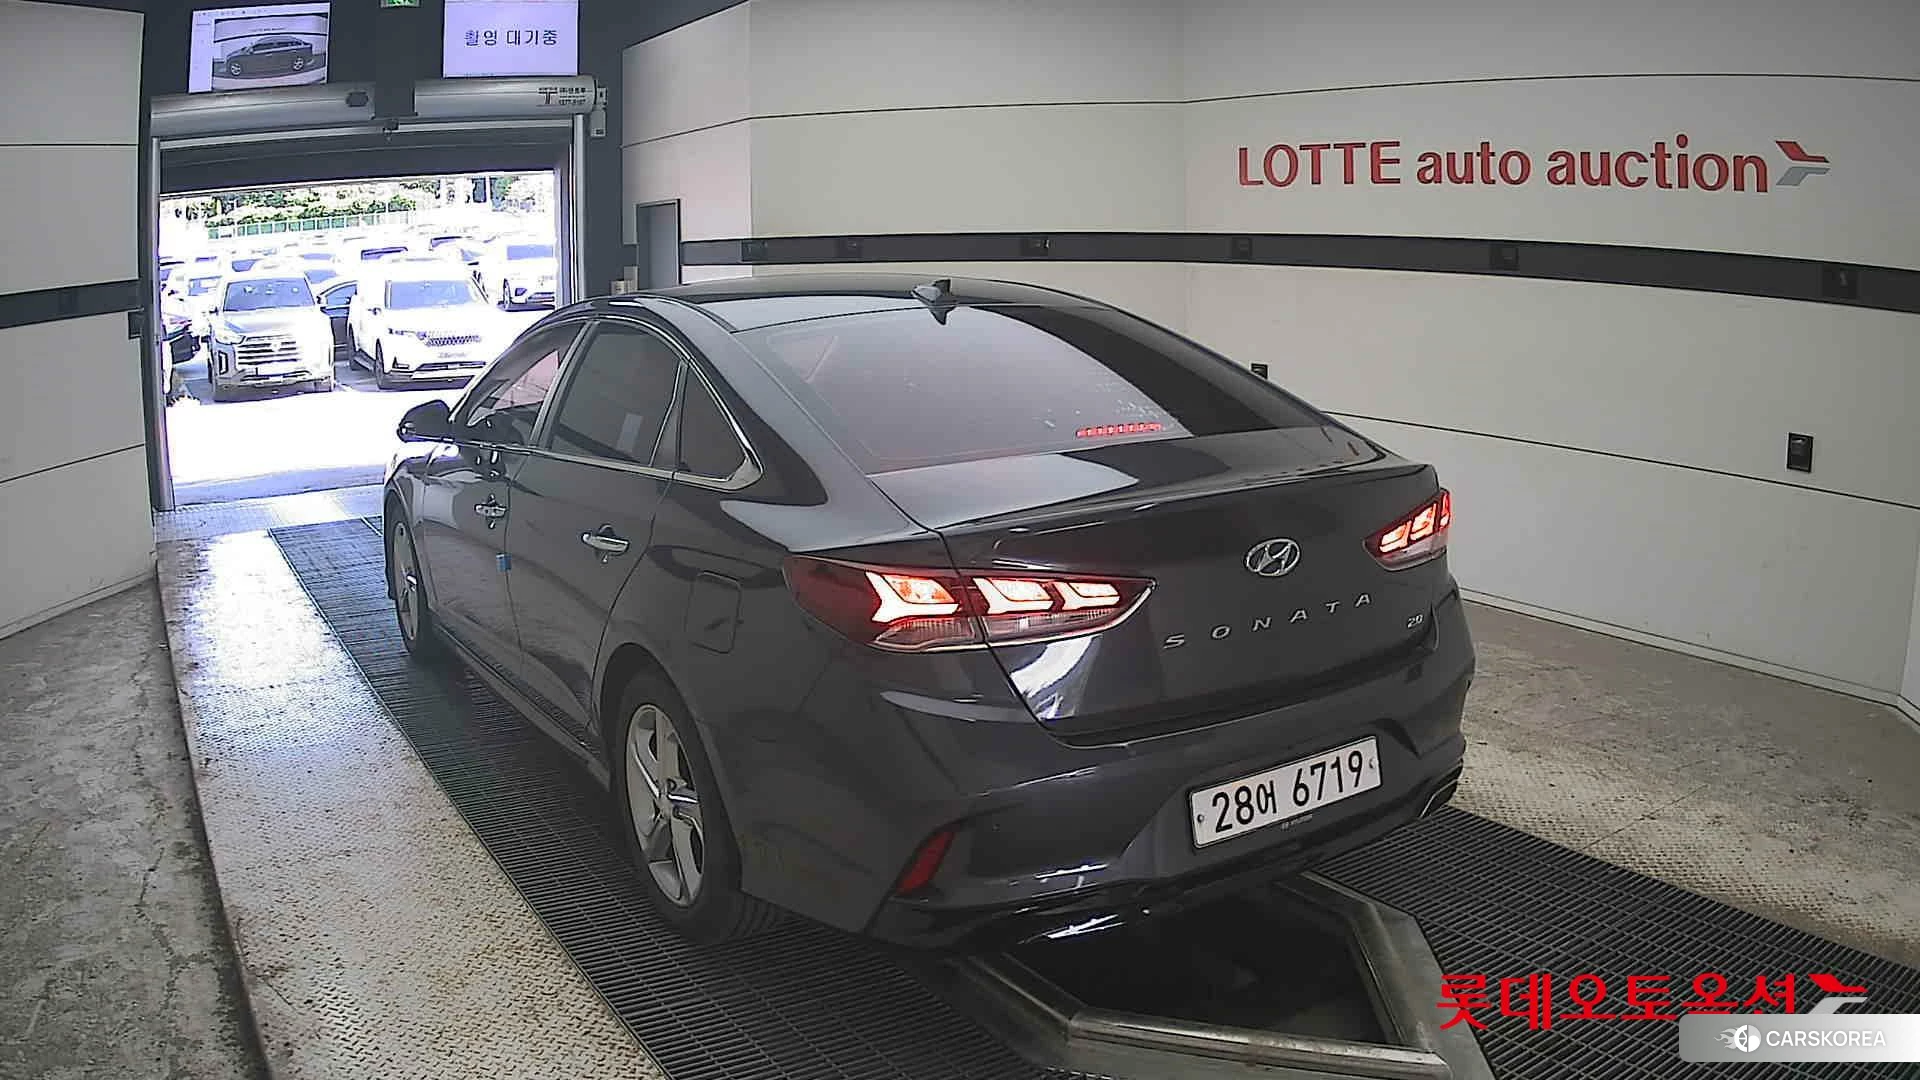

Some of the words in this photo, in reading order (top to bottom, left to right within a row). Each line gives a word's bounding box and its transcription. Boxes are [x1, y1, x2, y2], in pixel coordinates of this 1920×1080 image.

[464, 30, 497, 46] 촬영
[507, 30, 558, 46] 대기중
[1239, 141, 1401, 187] LOTTE
[1416, 142, 1532, 187] auto
[1546, 133, 1769, 194] auction
[1163, 593, 1372, 649] SONATA
[1211, 780, 1277, 834] 28어
[1292, 750, 1363, 807] 6719
